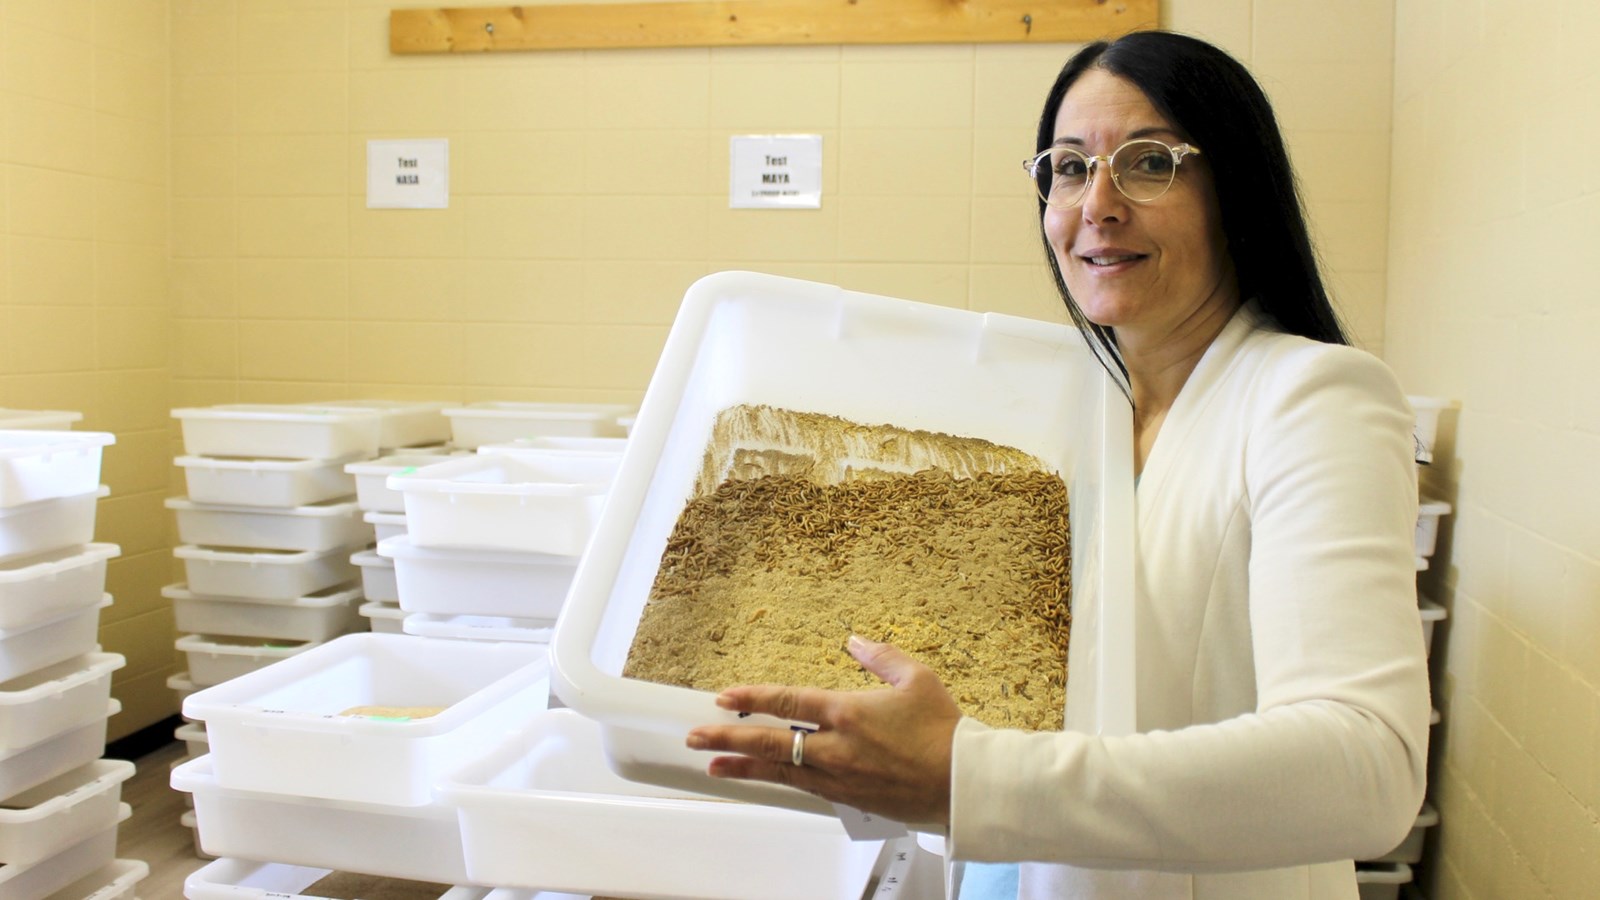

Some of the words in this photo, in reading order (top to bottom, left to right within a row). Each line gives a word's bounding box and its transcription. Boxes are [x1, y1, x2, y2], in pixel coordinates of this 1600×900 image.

[398, 157, 418, 168] Test
[765, 155, 787, 166] Test
[396, 175, 419, 185] NASA
[762, 174, 790, 184] MAYA
